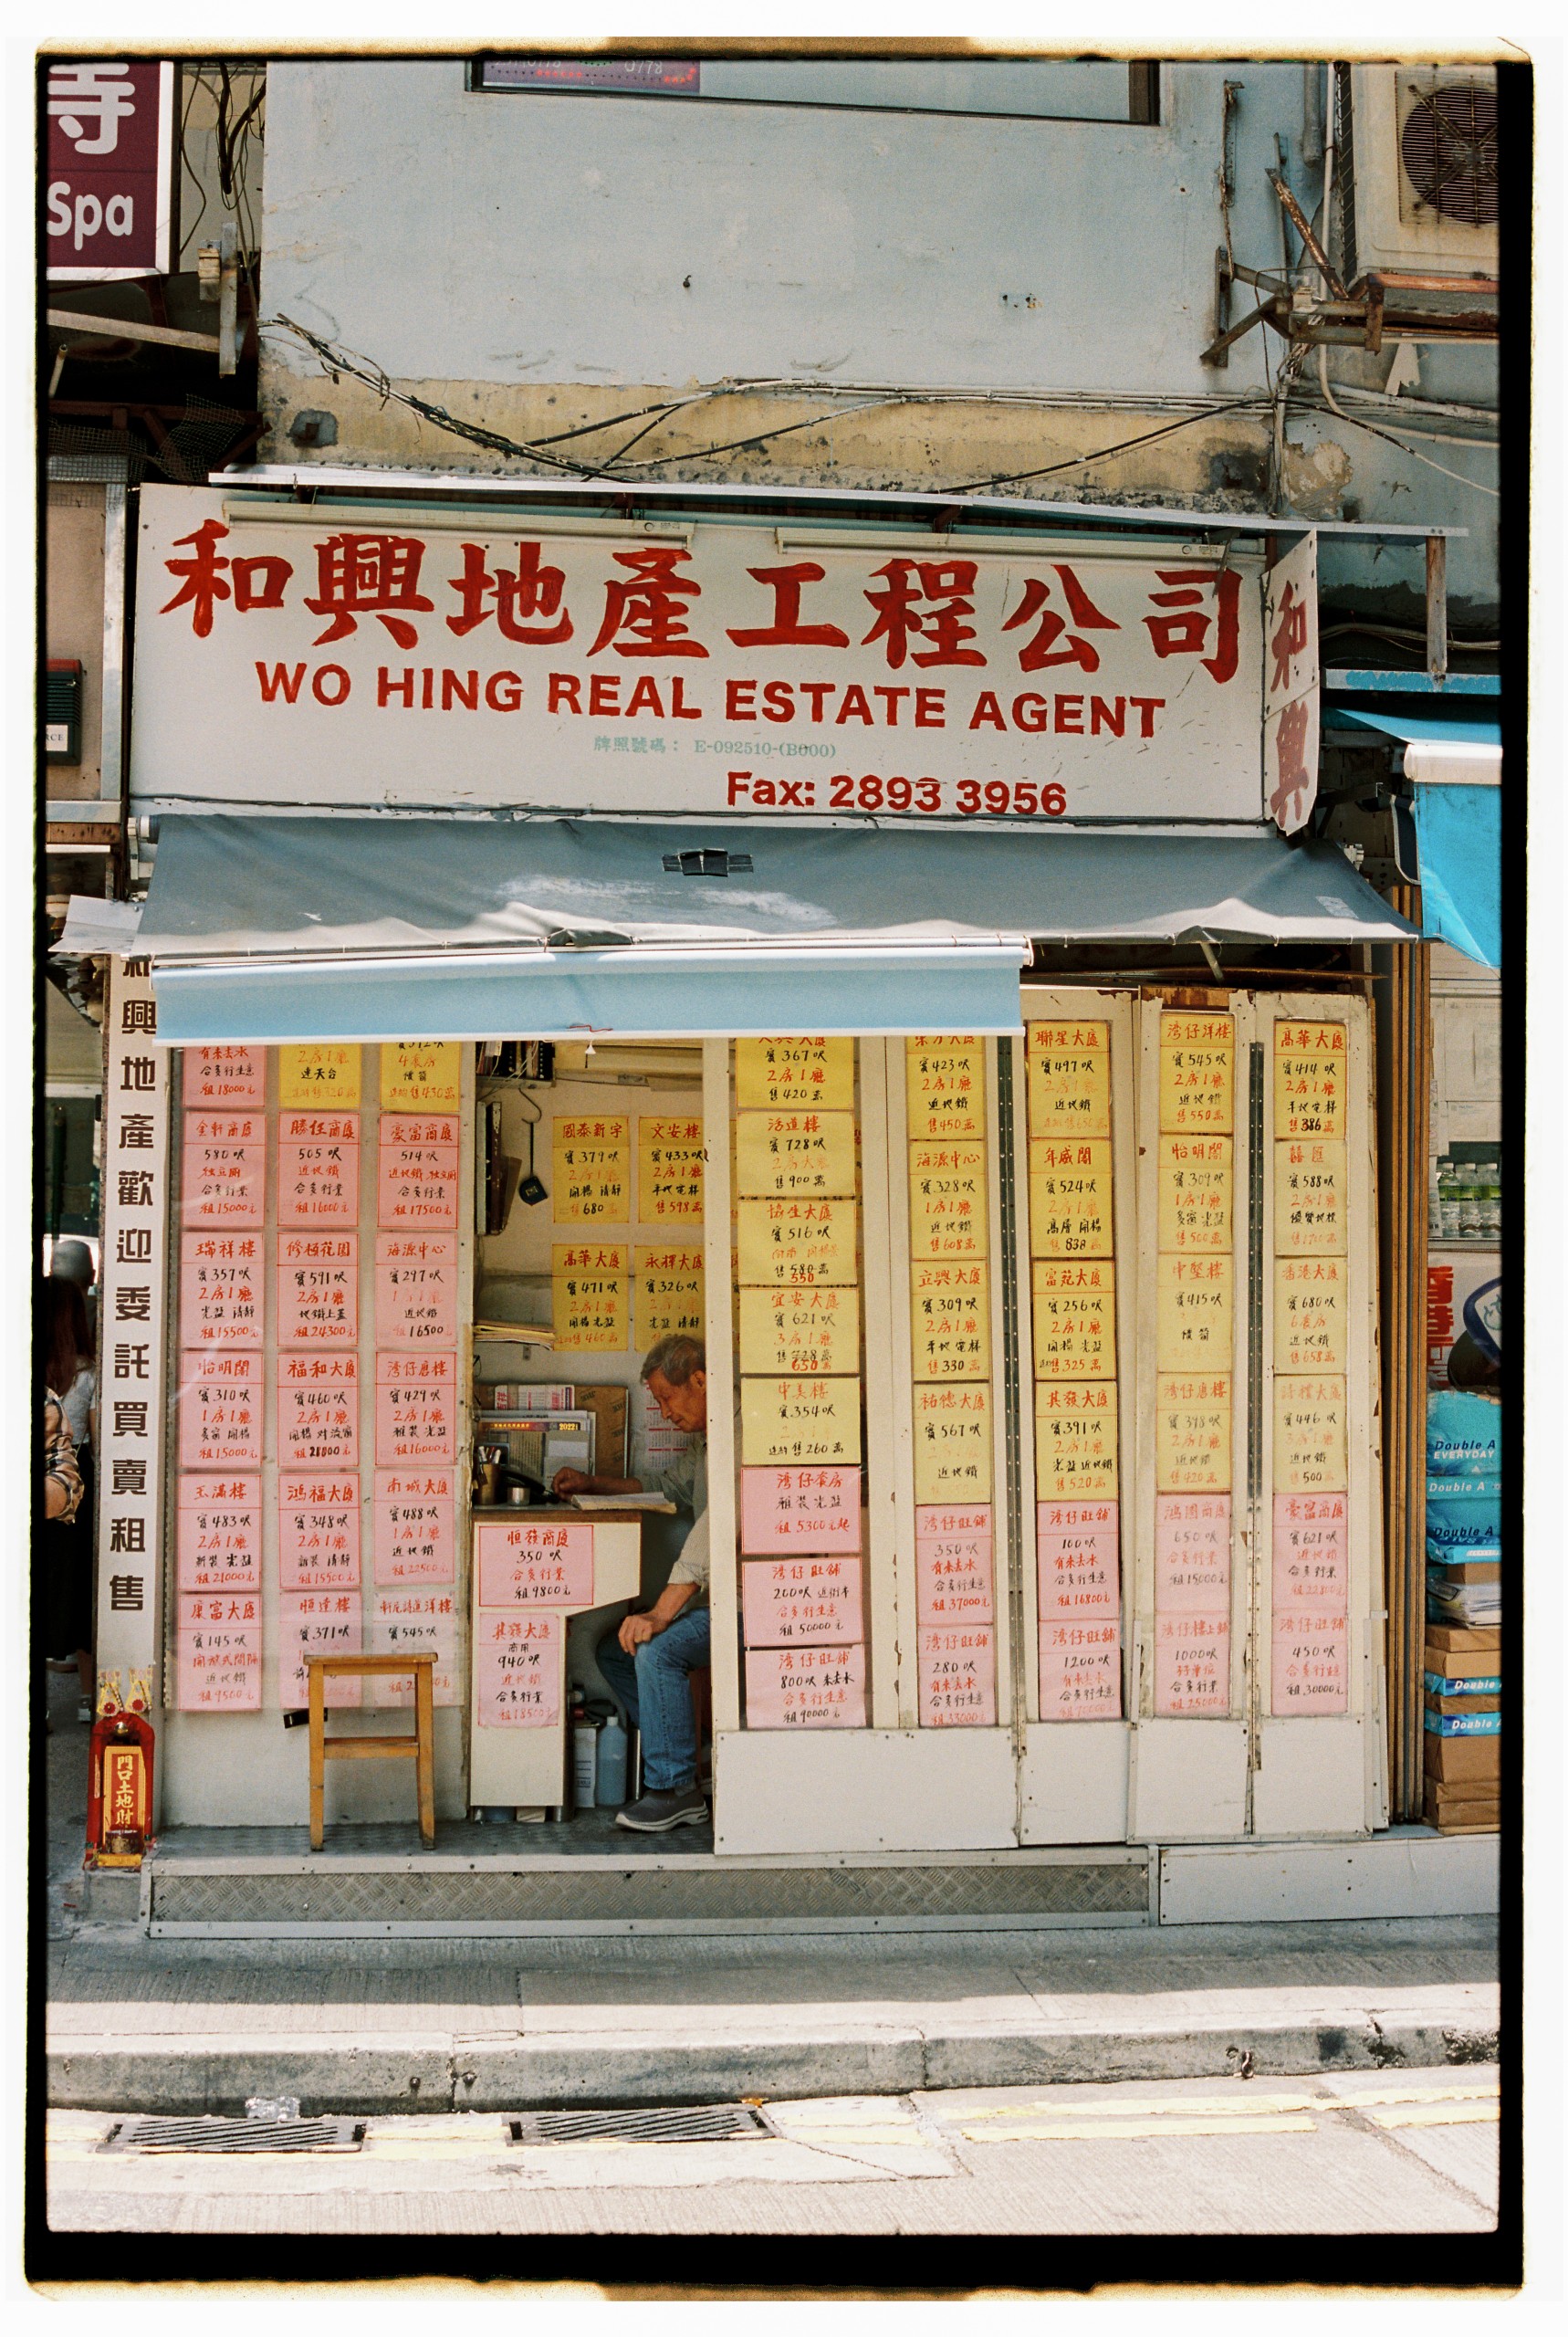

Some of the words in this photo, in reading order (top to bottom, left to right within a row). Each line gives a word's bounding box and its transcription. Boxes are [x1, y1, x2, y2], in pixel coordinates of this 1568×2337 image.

[47, 181, 133, 251] Spa
[160, 519, 1242, 684] 和興地產工程公司
[256, 660, 351, 706] WO
[377, 665, 522, 713] HING
[549, 672, 701, 719] REAL
[726, 679, 946, 728] ESTATE
[969, 691, 1166, 739] AGENT
[727, 770, 814, 808] Fax:
[830, 774, 941, 812] 2893
[956, 781, 1067, 816] 3956
[1435, 1441, 1482, 1451] Double
[1488, 1440, 1496, 1450] A
[1434, 1450, 1495, 1460] EVERYDAY
[1429, 1482, 1472, 1492] Double
[1477, 1482, 1485, 1491] A
[1434, 1526, 1479, 1536] Double
[1485, 1525, 1494, 1535] A
[1454, 1680, 1496, 1691] Double
[1452, 1719, 1492, 1730] Double
[115, 1755, 134, 1827] 門口土地財
